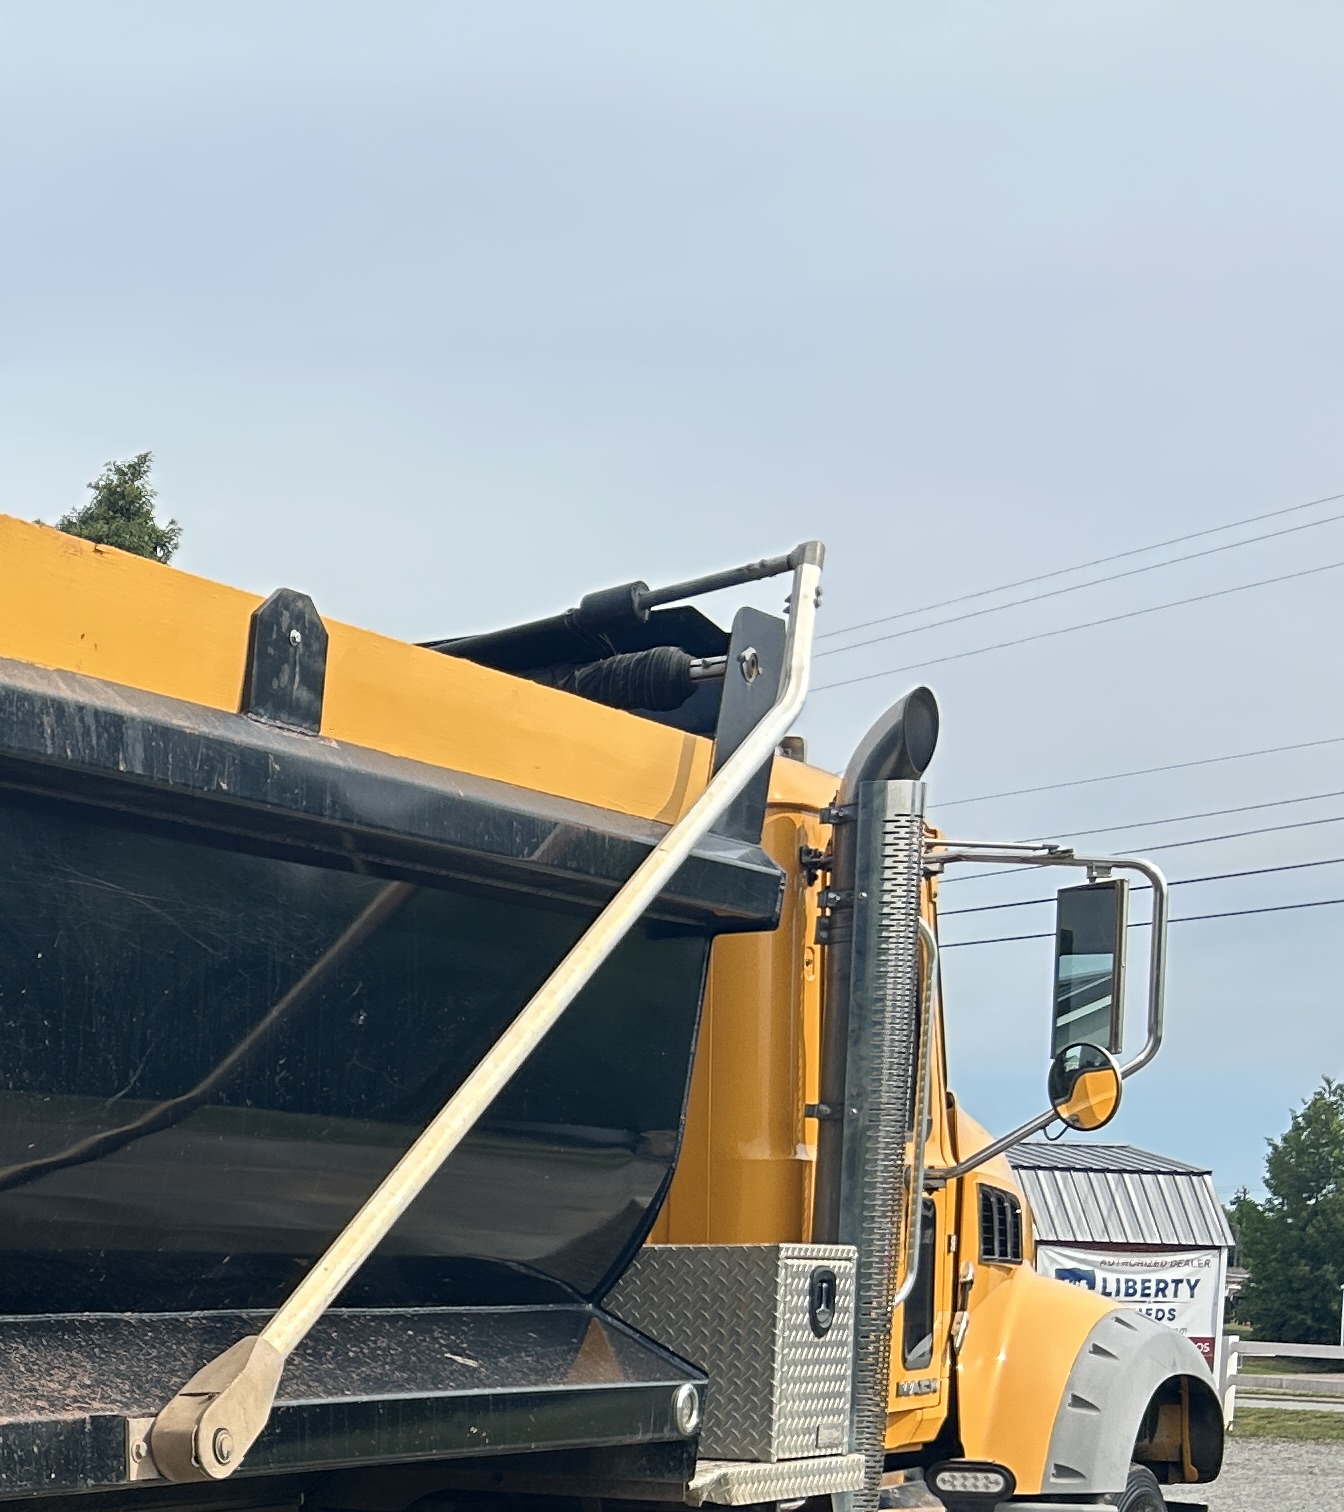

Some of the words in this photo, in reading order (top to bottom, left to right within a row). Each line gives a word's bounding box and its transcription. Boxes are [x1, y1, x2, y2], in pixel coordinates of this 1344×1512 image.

[1170, 1259, 1211, 1268] DEALER
[1101, 1277, 1201, 1299] LIBERTY
[1138, 1308, 1177, 1321] EDS
